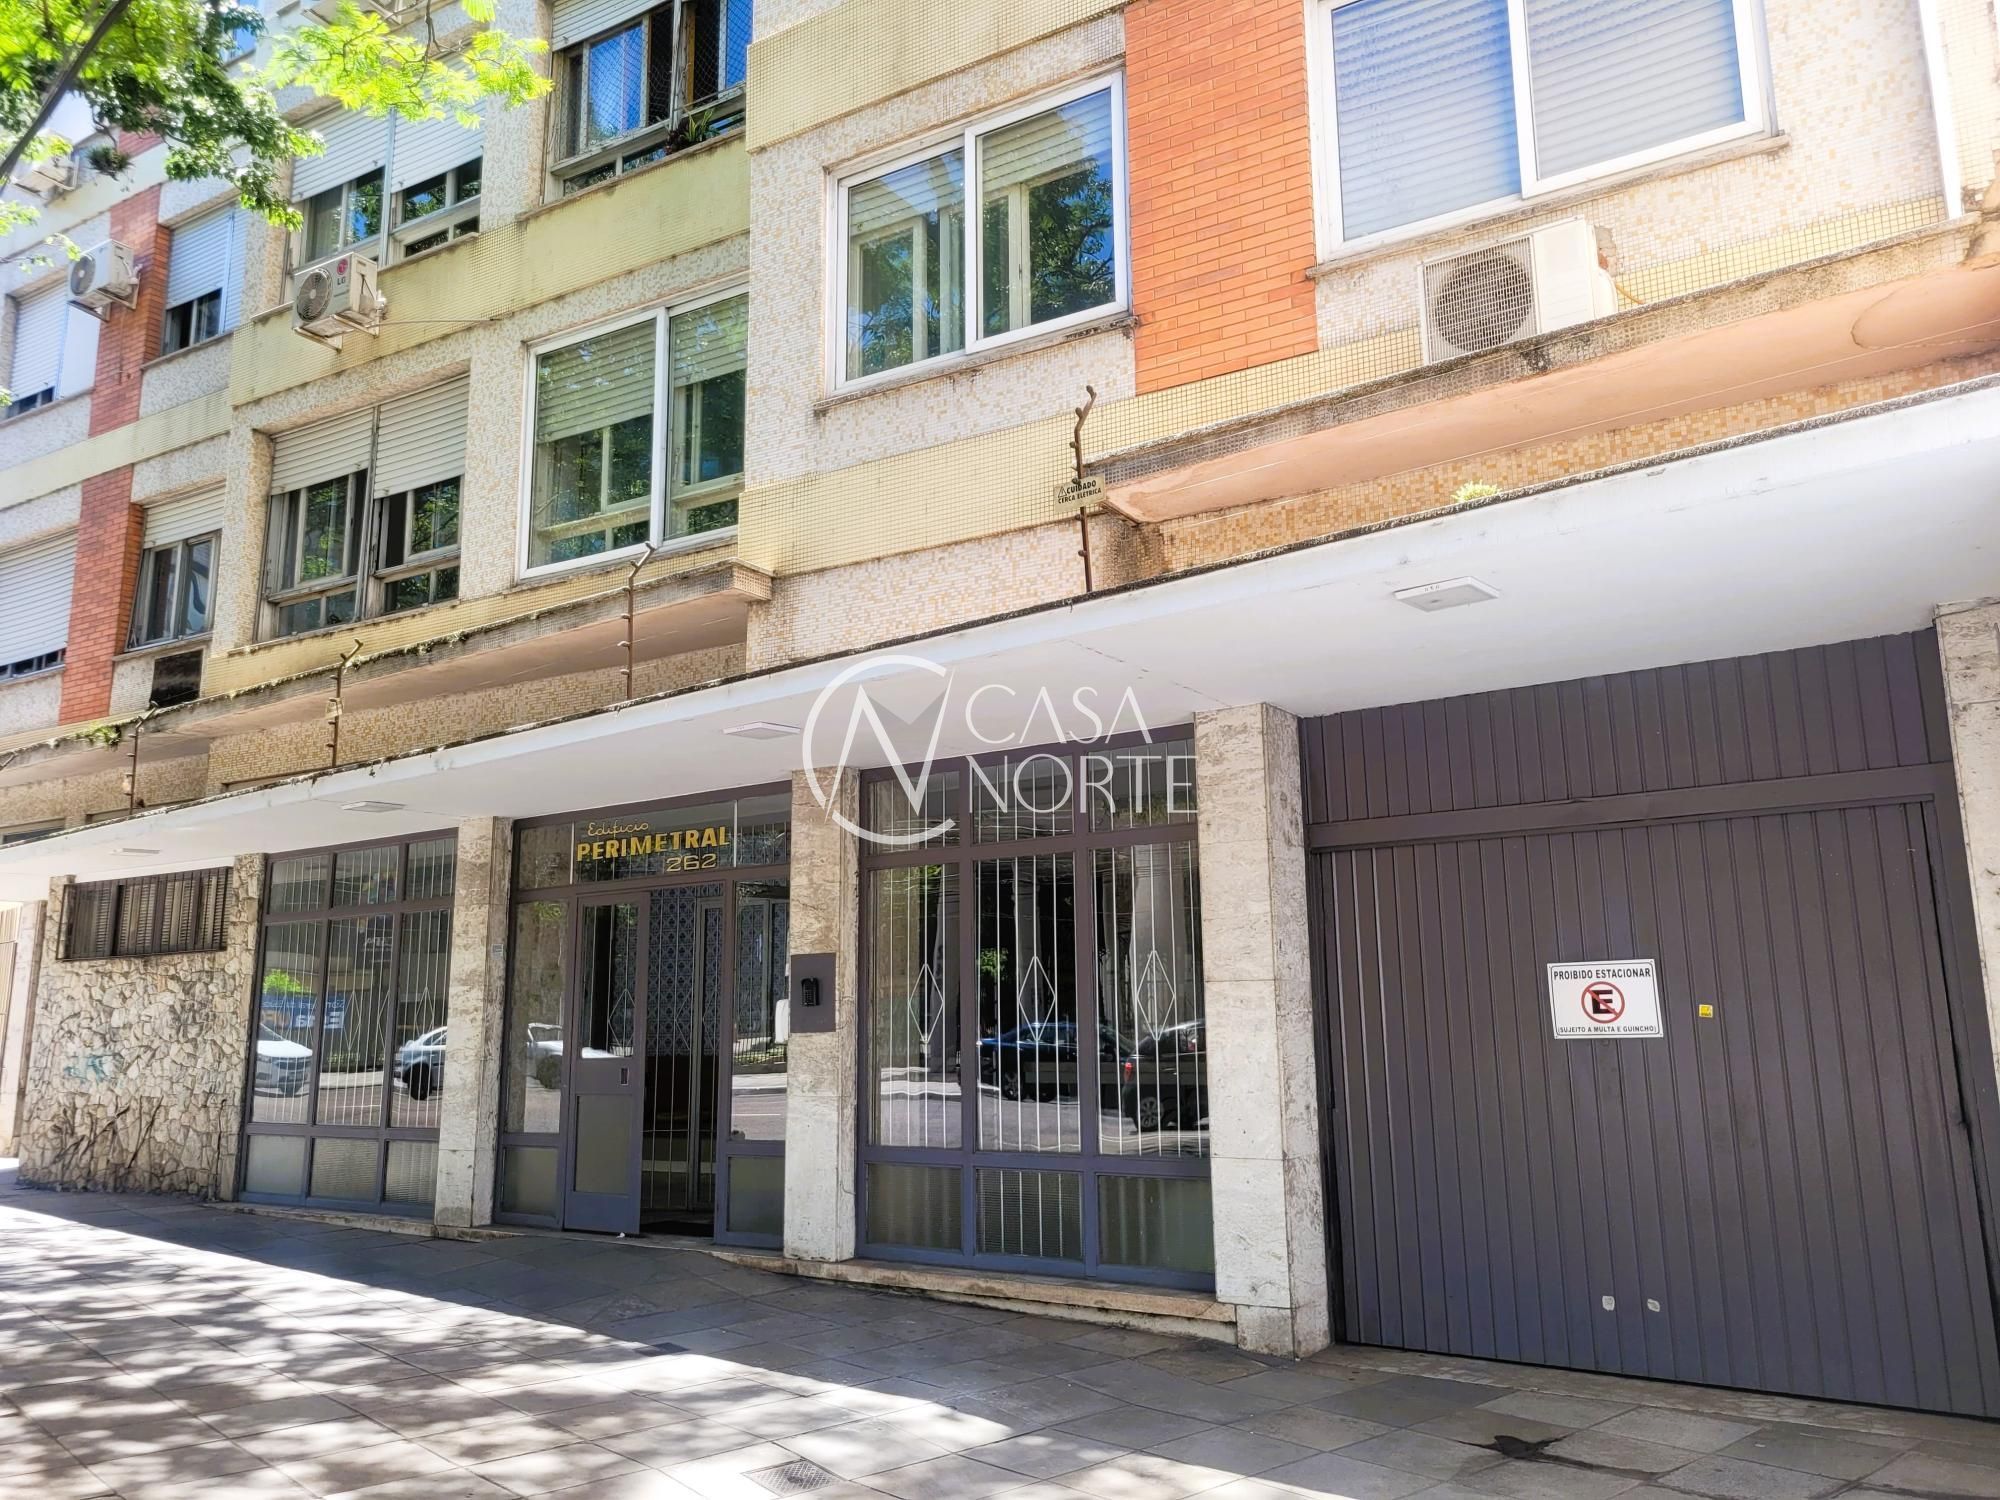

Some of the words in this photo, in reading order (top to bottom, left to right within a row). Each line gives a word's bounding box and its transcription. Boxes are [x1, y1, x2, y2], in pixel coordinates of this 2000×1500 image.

[1066, 480, 1097, 494] CUIDADO
[1058, 494, 1076, 504] CERCA
[576, 826, 730, 862] PERIMETRAL
[666, 853, 717, 872] 262
[1553, 969, 1593, 980] PROIBIDO
[1596, 967, 1651, 979] ESTACIONAR
